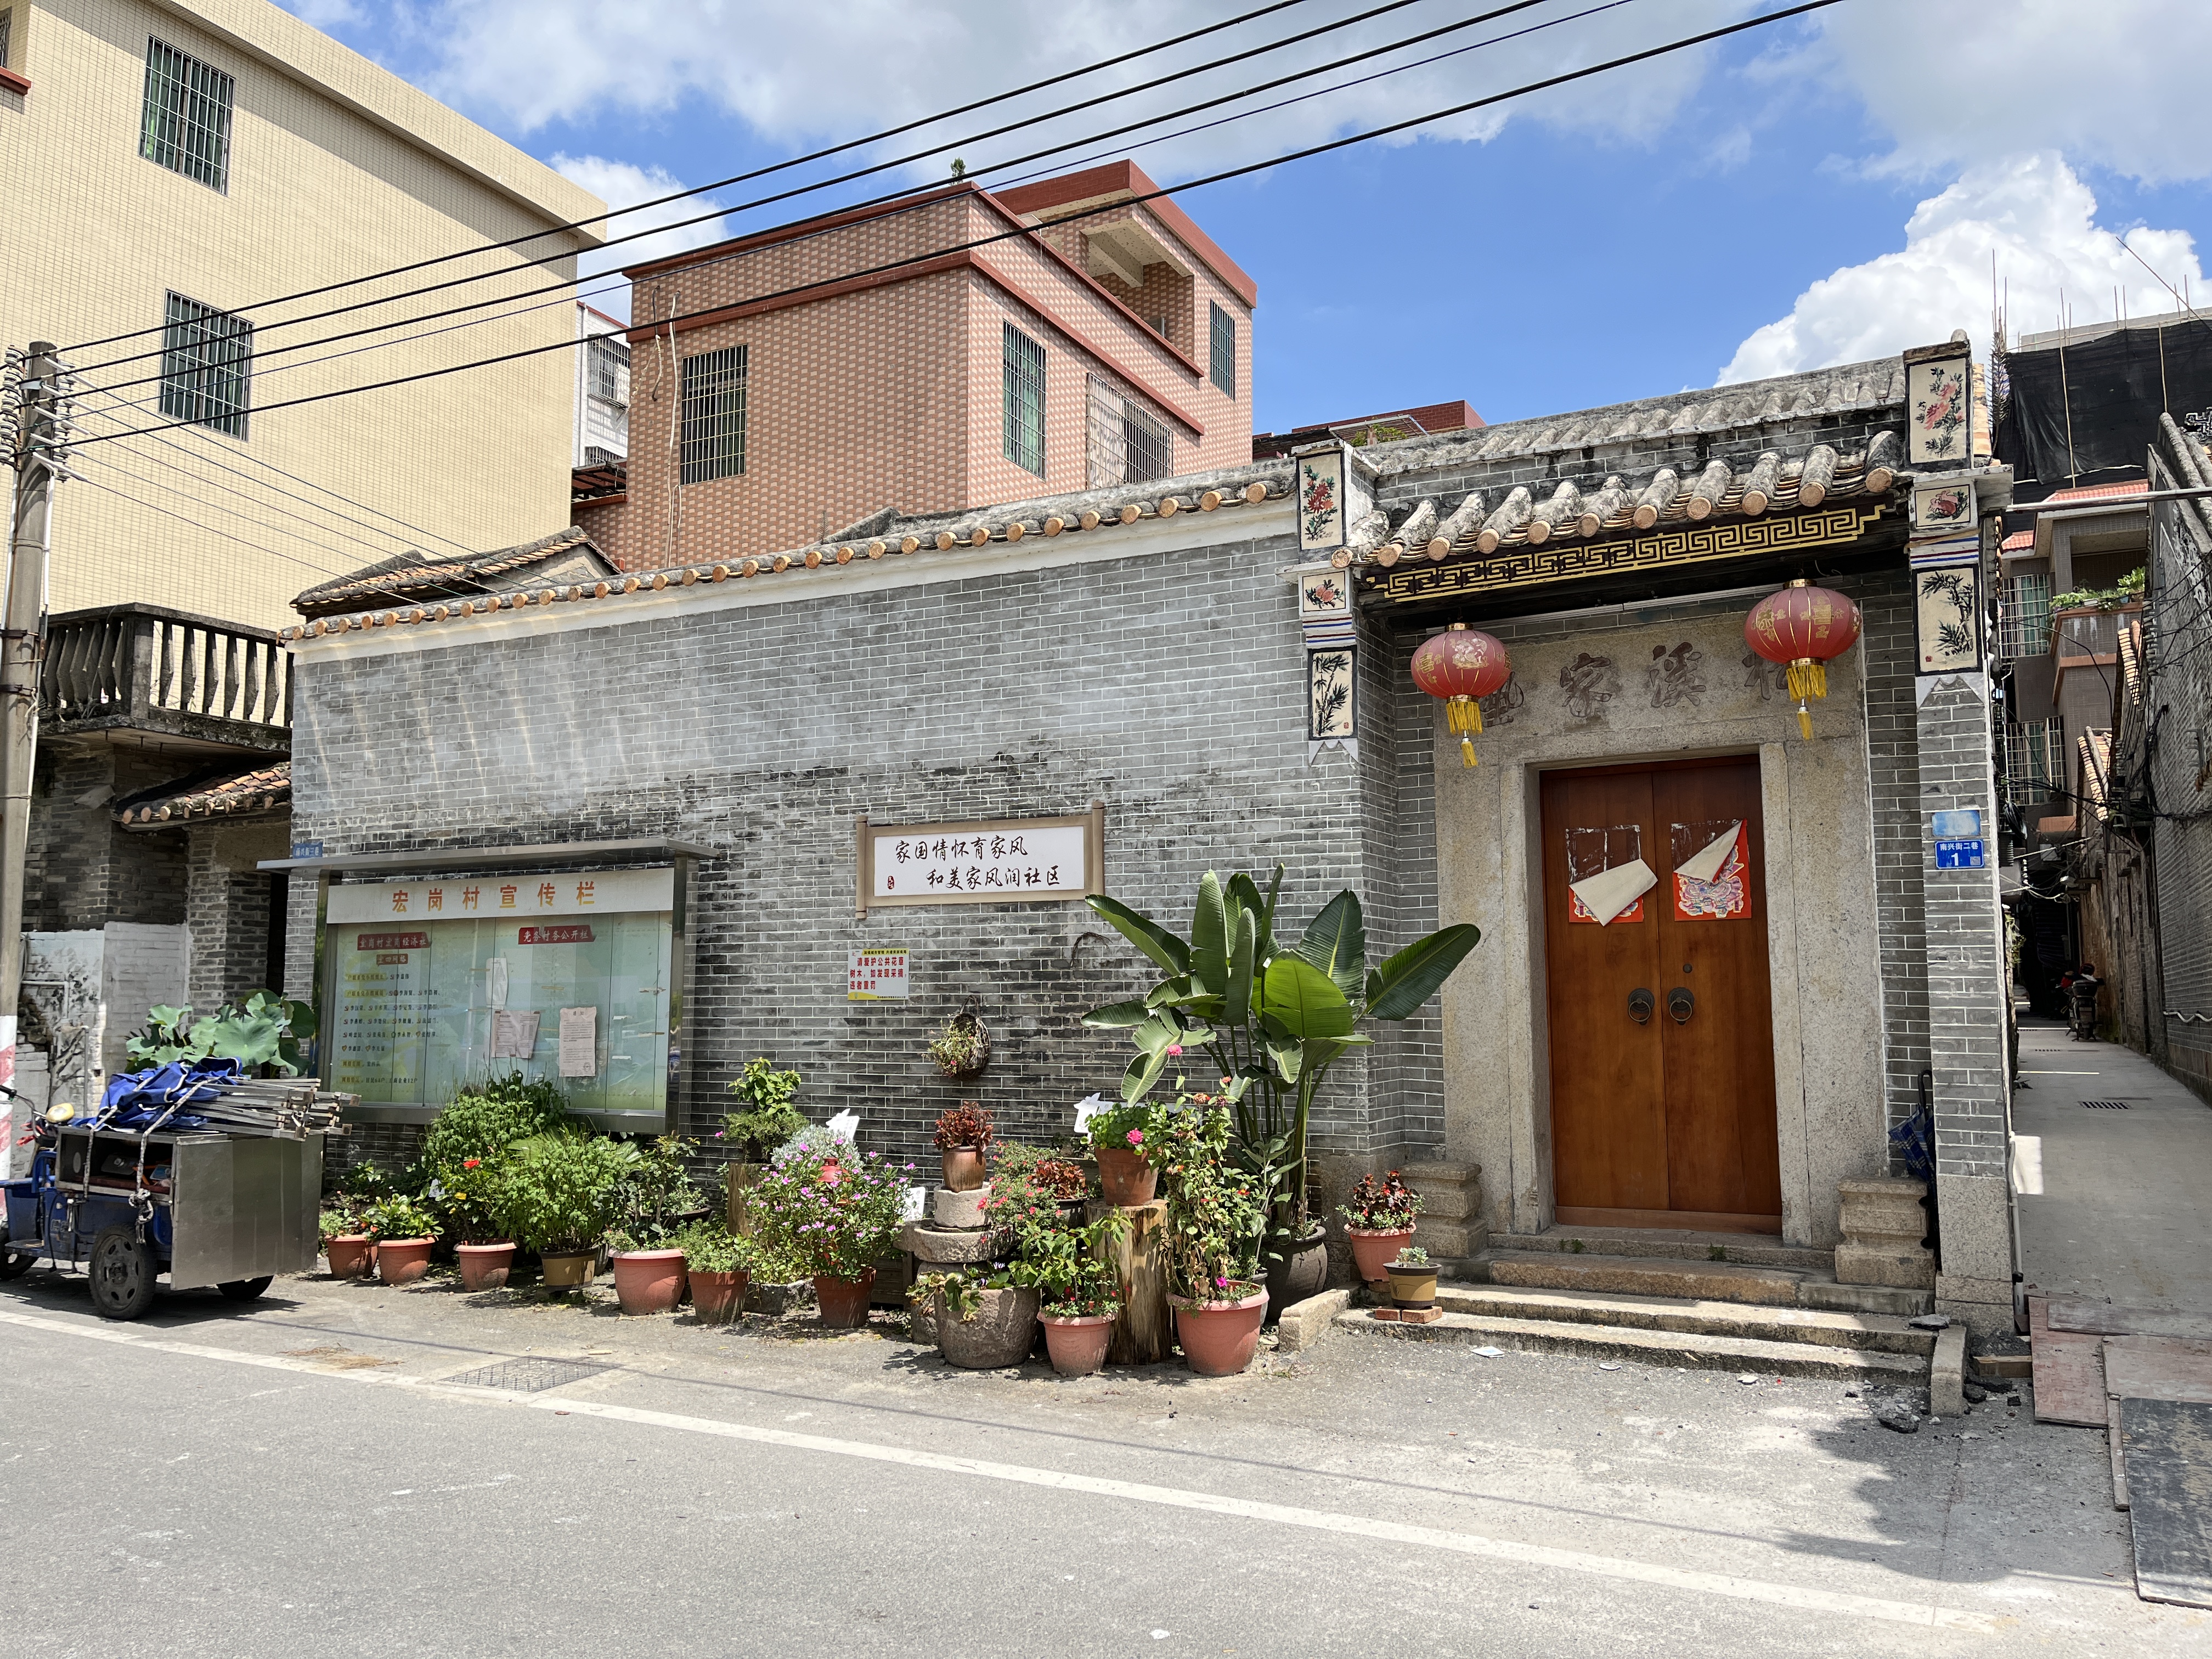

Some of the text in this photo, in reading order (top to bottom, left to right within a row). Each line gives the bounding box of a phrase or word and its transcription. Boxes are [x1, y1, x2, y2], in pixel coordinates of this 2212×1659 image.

[895, 835, 1028, 864] 家国情怀育家风
[1940, 842, 1979, 851] 南兴街二巷
[1951, 853, 1959, 866] 1
[926, 865, 1060, 891] 和美家风润社区
[392, 881, 595, 913] 宏岗村宣传栏
[523, 929, 588, 943] 党务村务公开栏
[857, 957, 904, 967] 请爱护公共花草
[850, 980, 876, 990] 违者重罚
